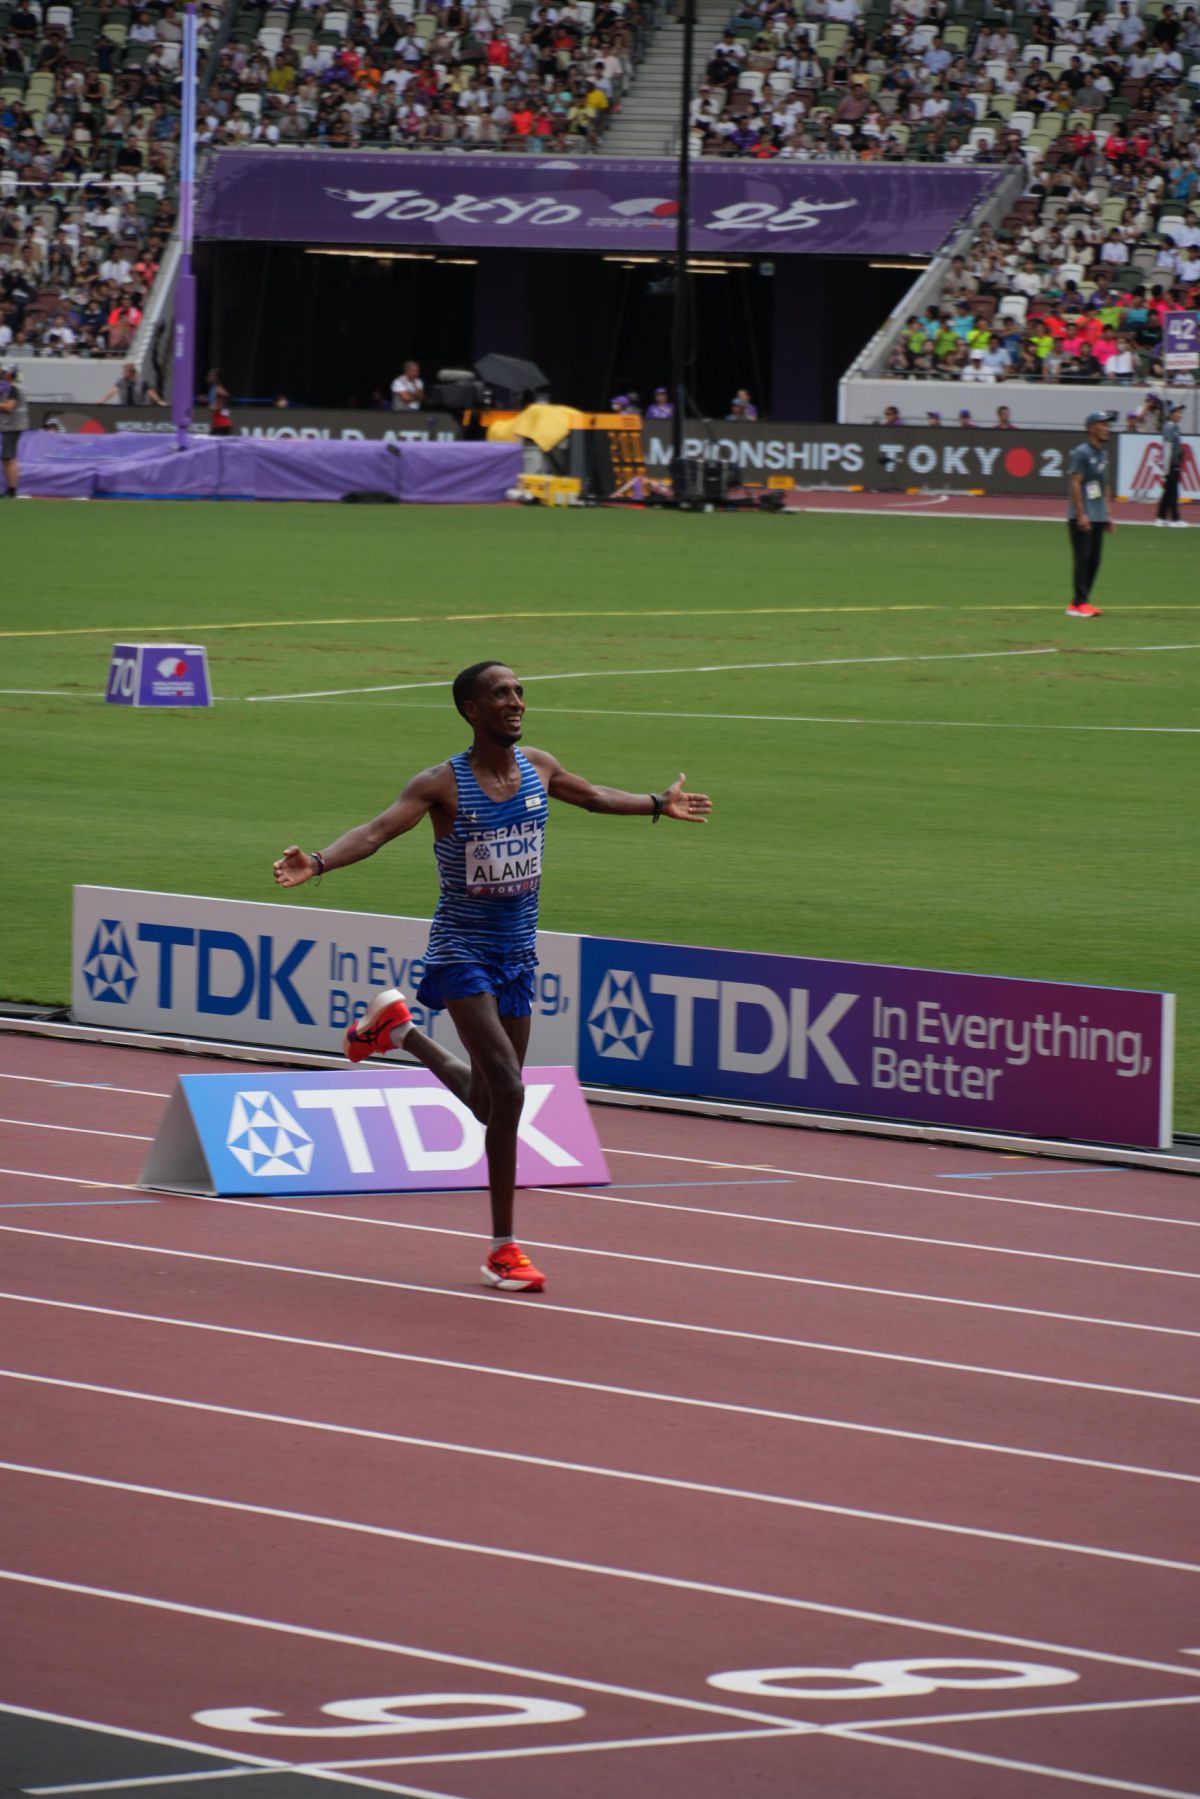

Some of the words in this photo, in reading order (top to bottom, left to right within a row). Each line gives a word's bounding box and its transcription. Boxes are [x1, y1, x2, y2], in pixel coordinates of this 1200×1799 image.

[321, 187, 582, 225] TOKYO
[704, 196, 858, 231] 25
[1168, 319, 1196, 339] 42
[646, 437, 865, 472] MPIONSHIPS
[110, 658, 137, 697] 70
[490, 836, 538, 858] TDK
[473, 857, 538, 882] ALAME
[136, 922, 318, 1026] TDK
[330, 942, 359, 983] In
[330, 989, 440, 1038] Beer
[650, 973, 860, 1086] TDK
[872, 996, 907, 1041] In
[917, 1000, 1152, 1078] Everything,
[872, 1046, 1003, 1101] Better
[292, 1084, 584, 1173] TDK
[706, 1658, 1080, 1699] 8
[191, 1693, 586, 1738] 9
